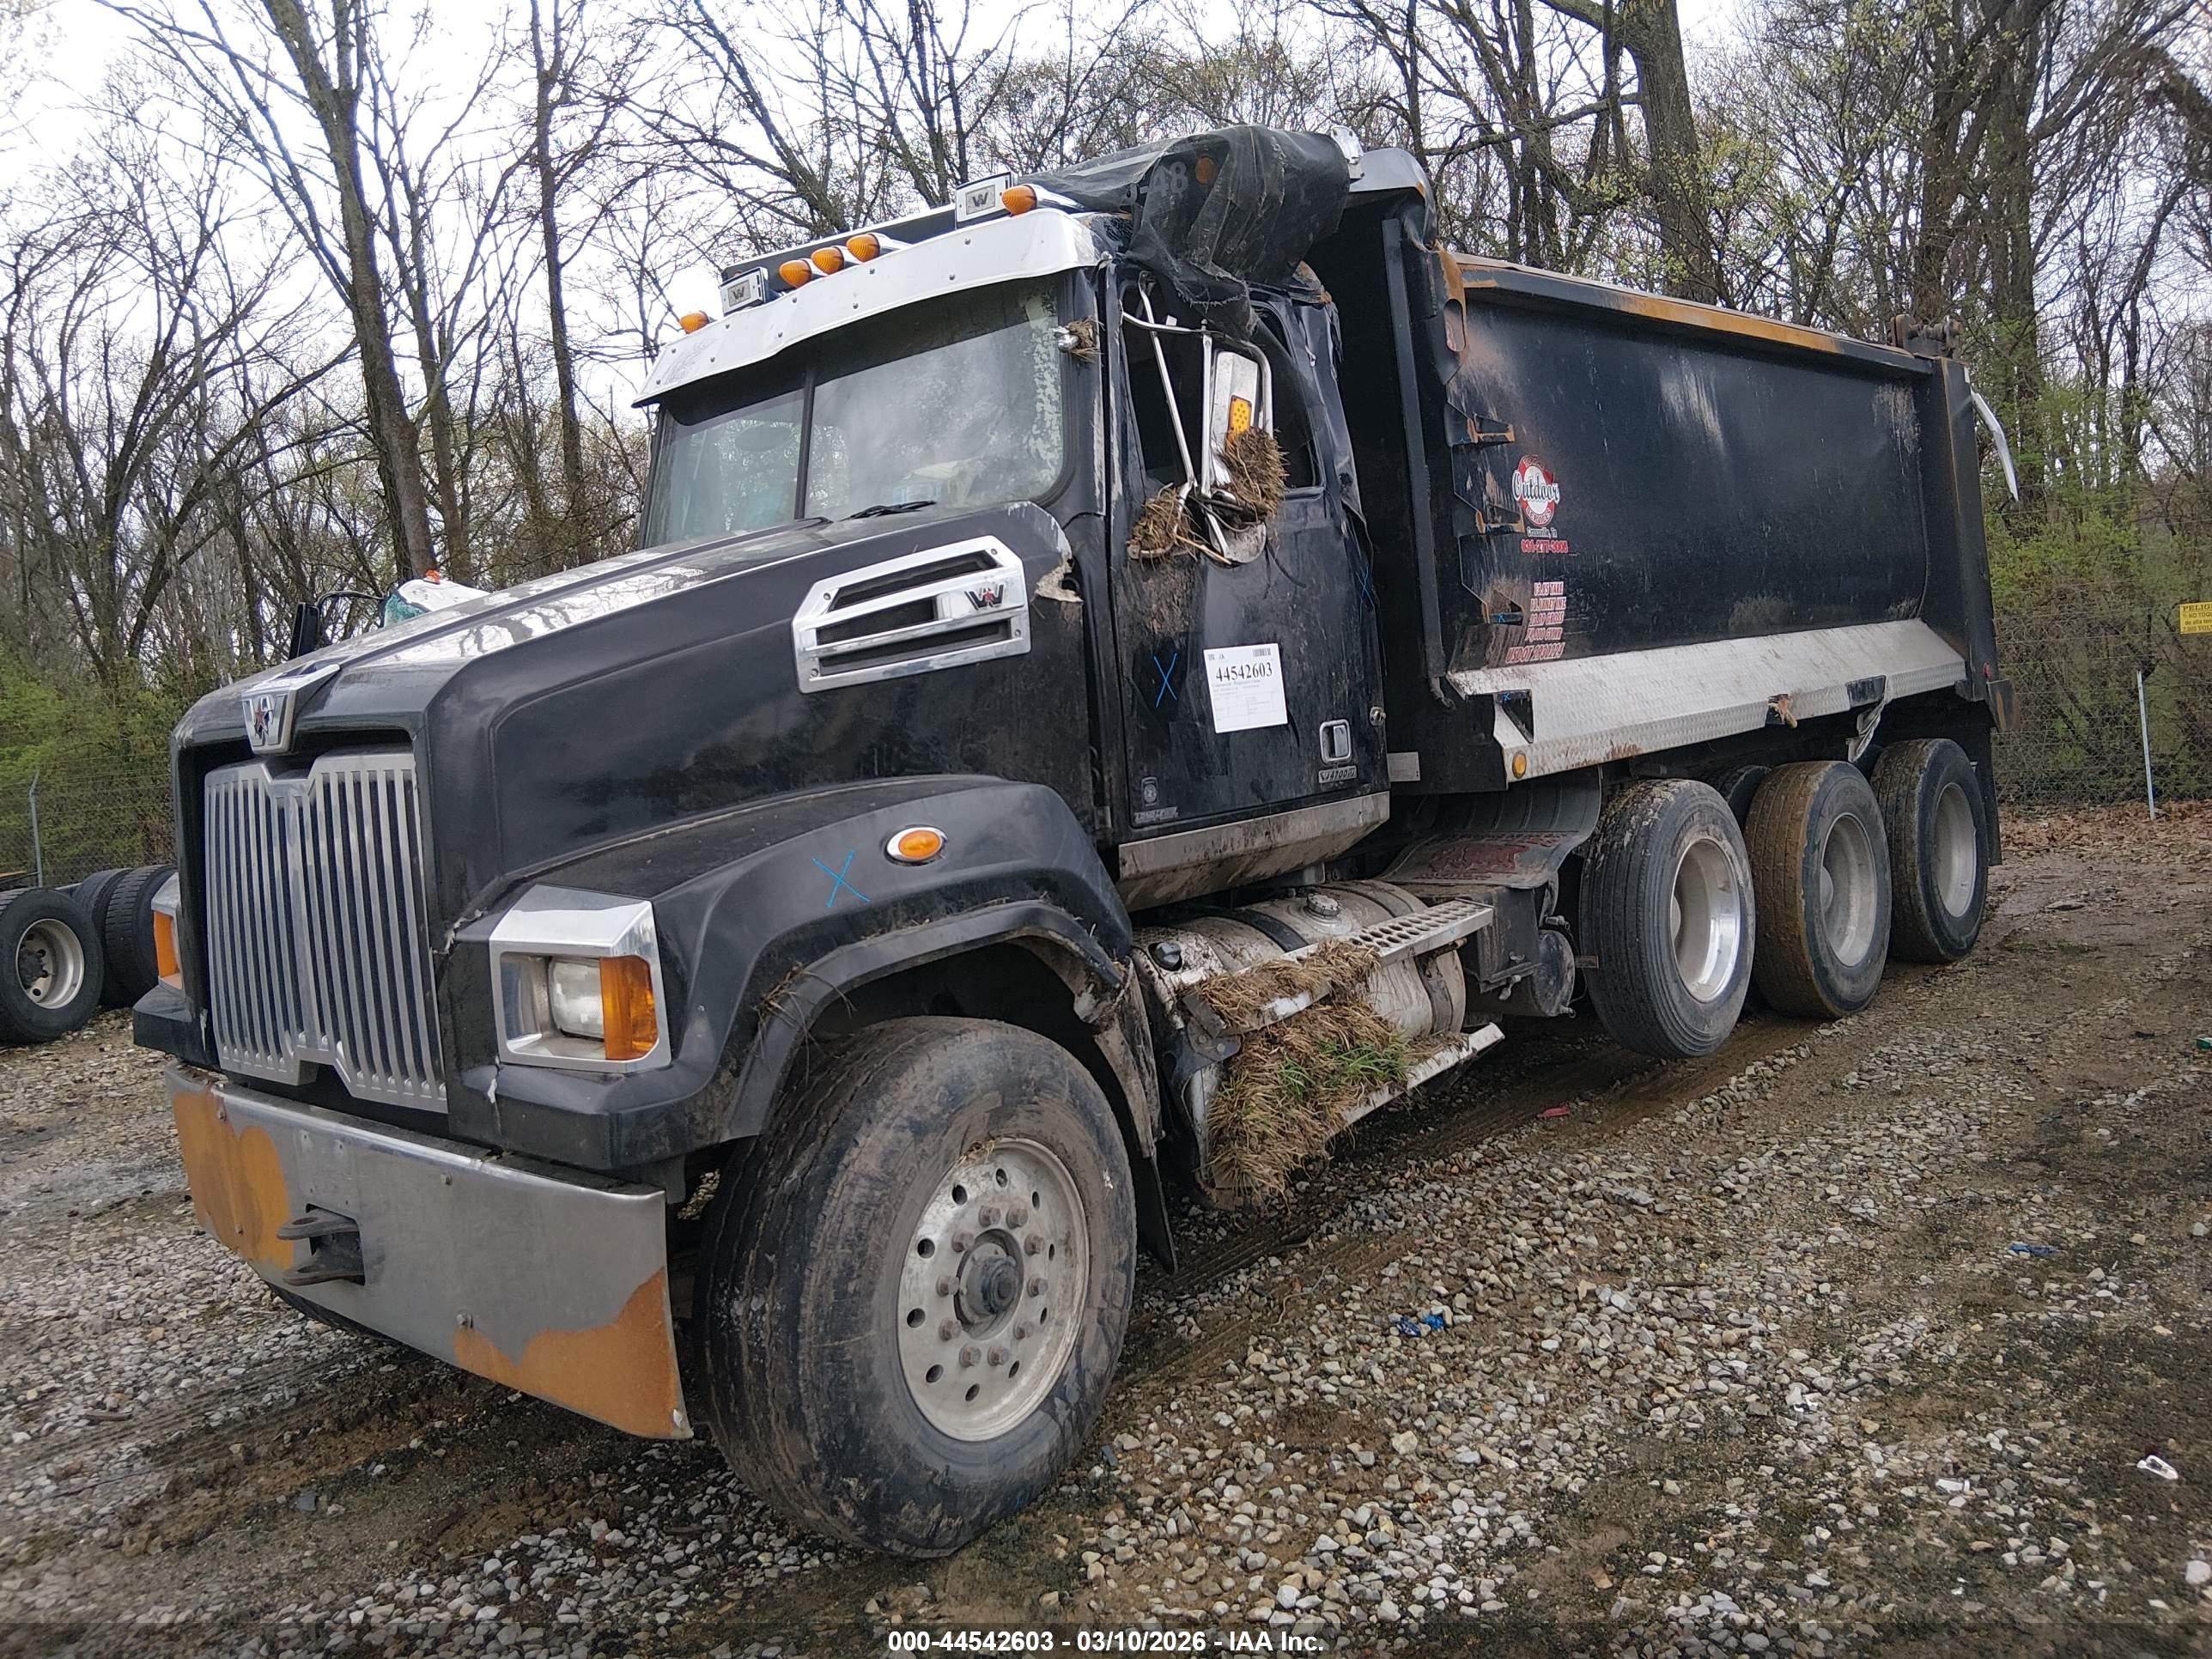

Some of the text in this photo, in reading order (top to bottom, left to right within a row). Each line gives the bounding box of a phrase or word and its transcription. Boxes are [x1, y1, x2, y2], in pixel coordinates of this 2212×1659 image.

[1512, 470, 1559, 503] Outdoor
[1505, 646, 1534, 663] USDOT
[1216, 662, 1273, 682] 44542603
